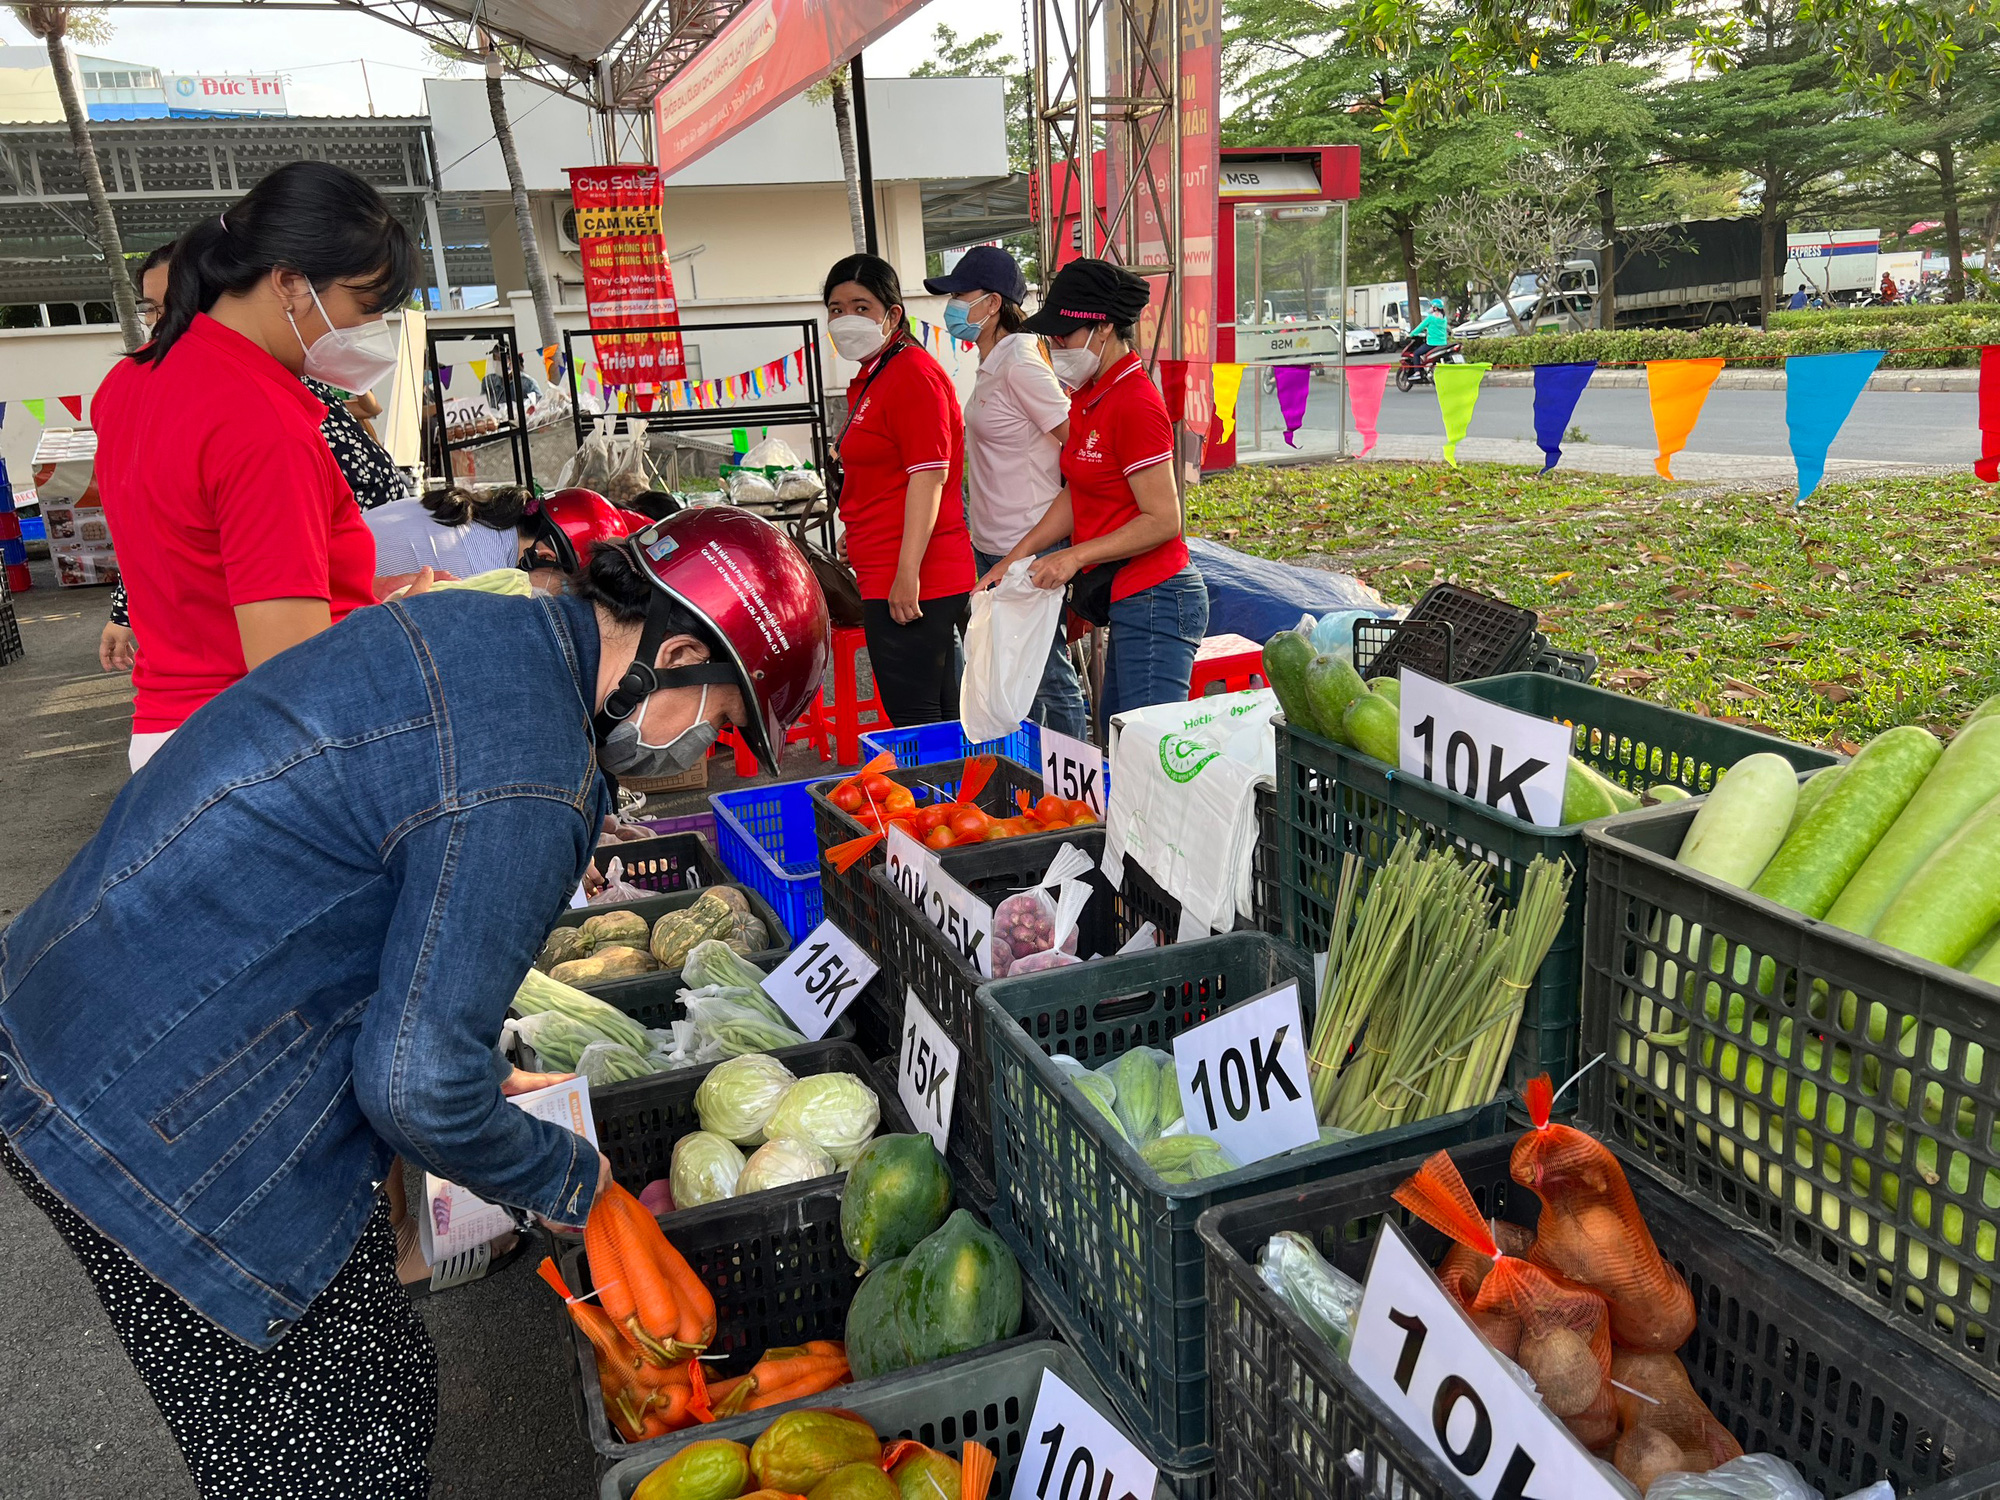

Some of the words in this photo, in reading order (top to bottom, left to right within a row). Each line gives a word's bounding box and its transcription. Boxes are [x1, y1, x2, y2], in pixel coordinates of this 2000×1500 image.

[199, 77, 246, 96] Đức
[246, 76, 281, 96] Trí
[577, 177, 609, 192] Chợ
[1227, 173, 1260, 185] MSB
[584, 217, 620, 230] CAM
[625, 211, 655, 228] KẾT
[596, 242, 612, 255] NÓI
[614, 241, 640, 254] KHÔNG
[642, 240, 656, 253] VỚI
[1790, 245, 1822, 258] EXPRESS
[590, 256, 614, 268] HÀNG
[615, 255, 641, 266] TRUNG
[643, 252, 664, 265] QUỐC
[592, 277, 612, 287] Truy
[614, 274, 630, 285] cập
[630, 273, 667, 283] Website
[608, 288, 627, 296] mua
[629, 285, 655, 295] online
[593, 302, 673, 313] www.chosale.com.vn
[1060, 308, 1107, 321] HUMMER
[601, 351, 635, 373] Triệu
[639, 352, 654, 368] ưu
[446, 404, 485, 424] 20K
[708, 540, 722, 552] NHÀ
[717, 549, 730, 561] VĂN
[725, 558, 738, 571] HÓA
[734, 569, 746, 583] PHỤ
[749, 588, 765, 608] THÀNH
[761, 605, 776, 620] PHỐ
[774, 626, 785, 638] CHÍ
[779, 635, 790, 651] MINH
[1414, 714, 1550, 825] 10K
[1047, 751, 1101, 816] 15K
[890, 854, 929, 916] 30K
[933, 890, 985, 975] 25K
[794, 941, 859, 1018] 15K
[907, 1022, 950, 1128] 15K
[1191, 1023, 1302, 1131] 10K
[1036, 1422, 1139, 1500] 10
